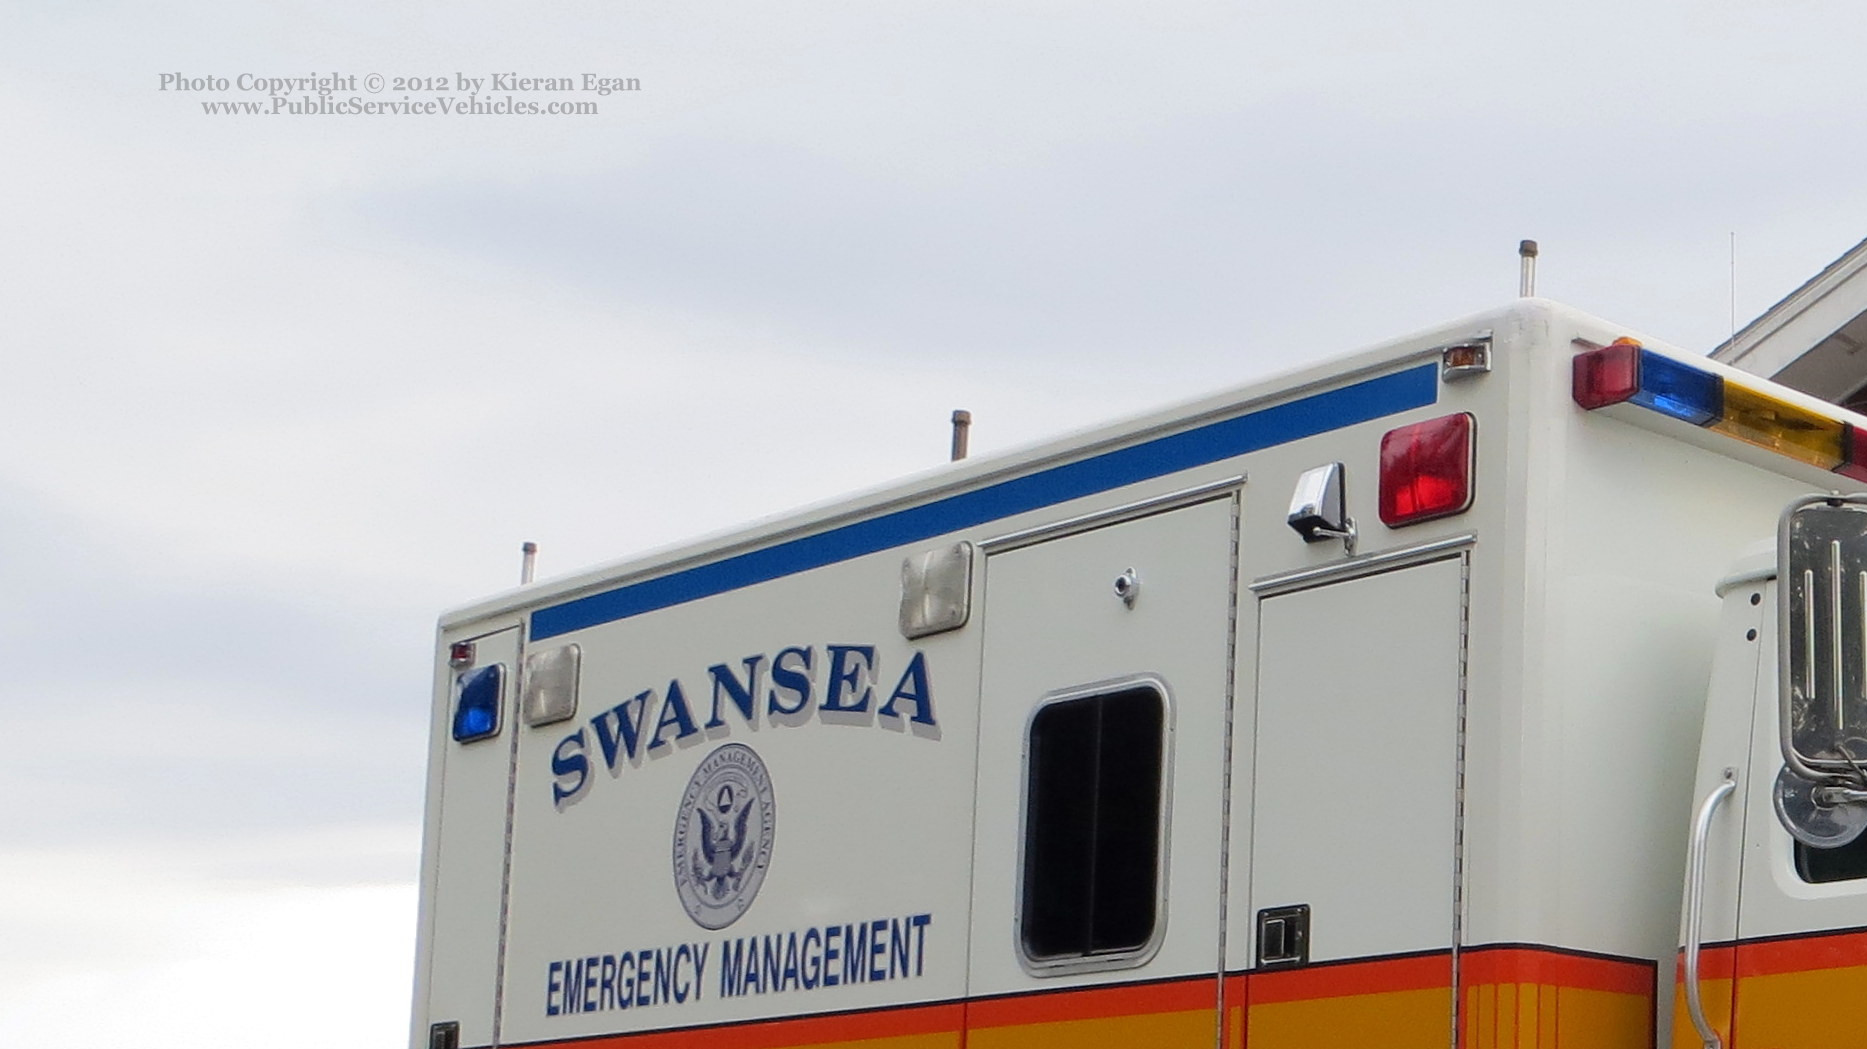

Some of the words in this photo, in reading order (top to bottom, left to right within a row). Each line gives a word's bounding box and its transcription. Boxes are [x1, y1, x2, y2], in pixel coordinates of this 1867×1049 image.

[551, 645, 938, 804] SWANSEA
[546, 945, 707, 1016] EMERGENCY
[720, 914, 931, 998] MANAGEMENT
